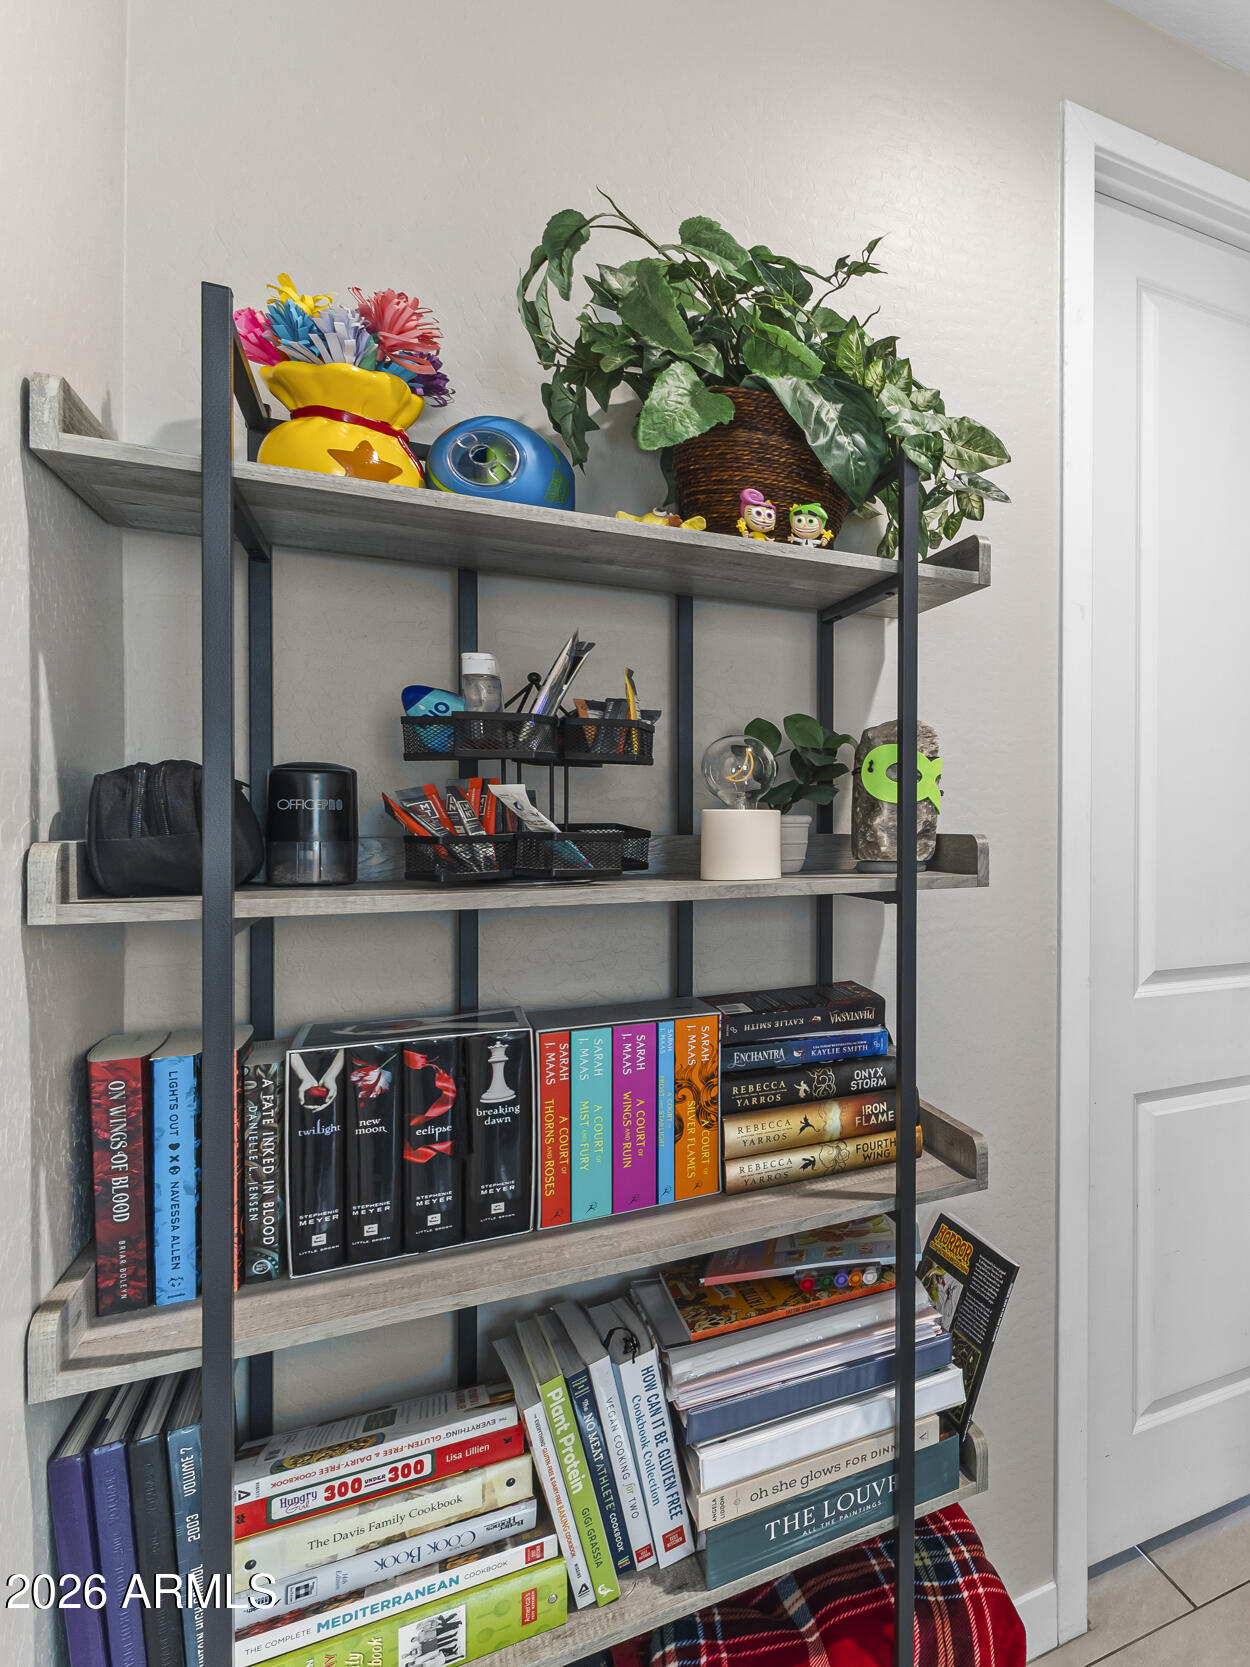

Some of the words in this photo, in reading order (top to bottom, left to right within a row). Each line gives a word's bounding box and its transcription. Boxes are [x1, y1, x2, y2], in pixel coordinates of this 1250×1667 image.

[744, 1022, 772, 1032] SMITH
[774, 1018, 804, 1028] KAYLIE
[828, 1006, 876, 1025] PHANTASMA
[636, 1034, 646, 1071] SARAH
[687, 1034, 696, 1066] MAAS
[701, 1025, 710, 1062] SARAH
[811, 1047, 841, 1057] KAYLIE
[843, 1044, 868, 1053] SMITH
[545, 1052, 556, 1086] MAAS
[559, 1043, 569, 1081] SARAH
[579, 1048, 590, 1081] MAAS
[593, 1038, 603, 1077] SARAH
[622, 1043, 632, 1075] MAAS
[730, 1048, 785, 1067] ENCHANTRA
[262, 1079, 273, 1088] A
[851, 1078, 887, 1091] STORM
[854, 1067, 884, 1081] ONYX
[108, 1080, 126, 1101] ON
[168, 1070, 179, 1111] LIGHTS
[732, 1081, 786, 1095] REBECCA
[737, 1094, 781, 1107] YARROS
[262, 1095, 274, 1125] FATE
[476, 1104, 520, 1117] breaking
[579, 1100, 590, 1126] MIST
[593, 1104, 603, 1112] A
[622, 1091, 633, 1127] WINGS
[636, 1098, 646, 1107] A
[862, 1102, 887, 1116] IRON
[109, 1104, 128, 1150] WINGS
[169, 1114, 179, 1136] OUT
[298, 1118, 341, 1137] twilight
[359, 1118, 382, 1127] new
[484, 1116, 511, 1126] dawn
[544, 1098, 555, 1145] THORNS
[559, 1115, 569, 1124] A
[636, 1110, 646, 1147] COURT
[687, 1101, 696, 1134] SILVER
[701, 1119, 710, 1127] A
[737, 1119, 791, 1135] REBECCA
[855, 1111, 895, 1128] FLAME
[248, 1105, 258, 1161] DANIELLE
[355, 1125, 388, 1136] moon
[415, 1125, 452, 1142] eclipse
[593, 1115, 604, 1153] COURT
[742, 1133, 788, 1147] YARROS
[262, 1131, 274, 1174] INKED
[559, 1127, 569, 1165] COURT
[579, 1143, 590, 1171] FURY
[622, 1142, 632, 1169] RUIN
[687, 1137, 696, 1179] FLAMES
[701, 1129, 710, 1165] COURT
[855, 1138, 897, 1155] FOURTH
[863, 1150, 891, 1162] WING
[110, 1152, 129, 1172] OF
[248, 1166, 258, 1176] L.
[739, 1158, 793, 1174] REBECCA
[262, 1180, 274, 1195] IN
[480, 1180, 515, 1189] STEPHENIE
[480, 1185, 515, 1195] MEYER
[544, 1160, 555, 1197] ROSES
[743, 1172, 789, 1187] YARROS
[111, 1176, 130, 1222] BLOOD
[170, 1181, 180, 1232] NAVESSA
[248, 1181, 259, 1222] JENSEN
[352, 1200, 391, 1211] STEPHENIE
[416, 1190, 453, 1200] STEPHENIE
[416, 1195, 453, 1207] MEYER
[262, 1201, 275, 1245] BLOOD
[299, 1208, 339, 1220] STEPHENIE
[299, 1214, 339, 1227] MEYER
[352, 1205, 391, 1216] MEYER
[118, 1240, 126, 1265] BRIAR
[171, 1235, 181, 1271] ALLEN
[934, 1223, 974, 1264] HORROR
[119, 1267, 128, 1299] BOLEYN
[641, 1365, 658, 1392] HOW
[606, 1396, 619, 1432] VEGAN
[646, 1393, 663, 1418] CAN
[445, 1418, 496, 1439] EVERYTHING
[584, 1412, 596, 1431] NO
[651, 1417, 665, 1430] IT
[382, 1434, 442, 1457] GLUTEN-FREE
[546, 1387, 570, 1435] Plant
[559, 1432, 585, 1495] Protein
[588, 1431, 604, 1462] MEAT
[632, 1394, 650, 1450] Cookbook
[643, 1451, 660, 1507] Collection
[654, 1430, 669, 1448] BE
[319, 1454, 372, 1475] DAIRY-FREE
[446, 1452, 463, 1463] Lisa
[465, 1443, 490, 1457] Lillien
[613, 1434, 631, 1480] COOKING
[180, 1455, 195, 1497] VOLUME
[271, 1471, 317, 1488] COOKBOOK
[323, 1477, 363, 1502] 300
[364, 1473, 386, 1484] UNDER
[388, 1459, 425, 1483] 300
[658, 1449, 678, 1492] GLUTEN
[750, 1487, 768, 1502] oh
[771, 1477, 797, 1496] she
[800, 1462, 842, 1489] glows
[845, 1454, 867, 1469] FOR
[871, 1444, 897, 1460] DINN
[596, 1462, 614, 1510] ATHLETE
[622, 1482, 635, 1494] for
[280, 1490, 318, 1509] Hungry
[628, 1498, 639, 1519] TWO
[666, 1491, 683, 1520] FREE
[765, 1506, 816, 1541] THE
[824, 1473, 896, 1518] LOUV
[186, 1513, 201, 1543] 2003
[307, 1539, 330, 1551] The
[333, 1527, 365, 1543] Davis
[367, 1511, 406, 1532] Family
[408, 1495, 463, 1518] Cookbook
[556, 1504, 571, 1532] BAKING
[565, 1531, 577, 1558] COOKBOOK
[802, 1527, 818, 1537] ALL
[820, 1519, 836, 1530] THE
[839, 1500, 882, 1522] PAINTINGS
[426, 1530, 476, 1555] COOK
[581, 1507, 593, 1528] GIGI
[587, 1528, 604, 1569] GRASSIA
[609, 1512, 625, 1553] COOKBOOK
[374, 1546, 421, 1572] BOOK
[244, 1645, 261, 1656] THE
[264, 1628, 312, 1649] COMPLETE
[316, 1575, 460, 1633] MEDITERRANEAN
[464, 1560, 509, 1580] COOKBOOK
